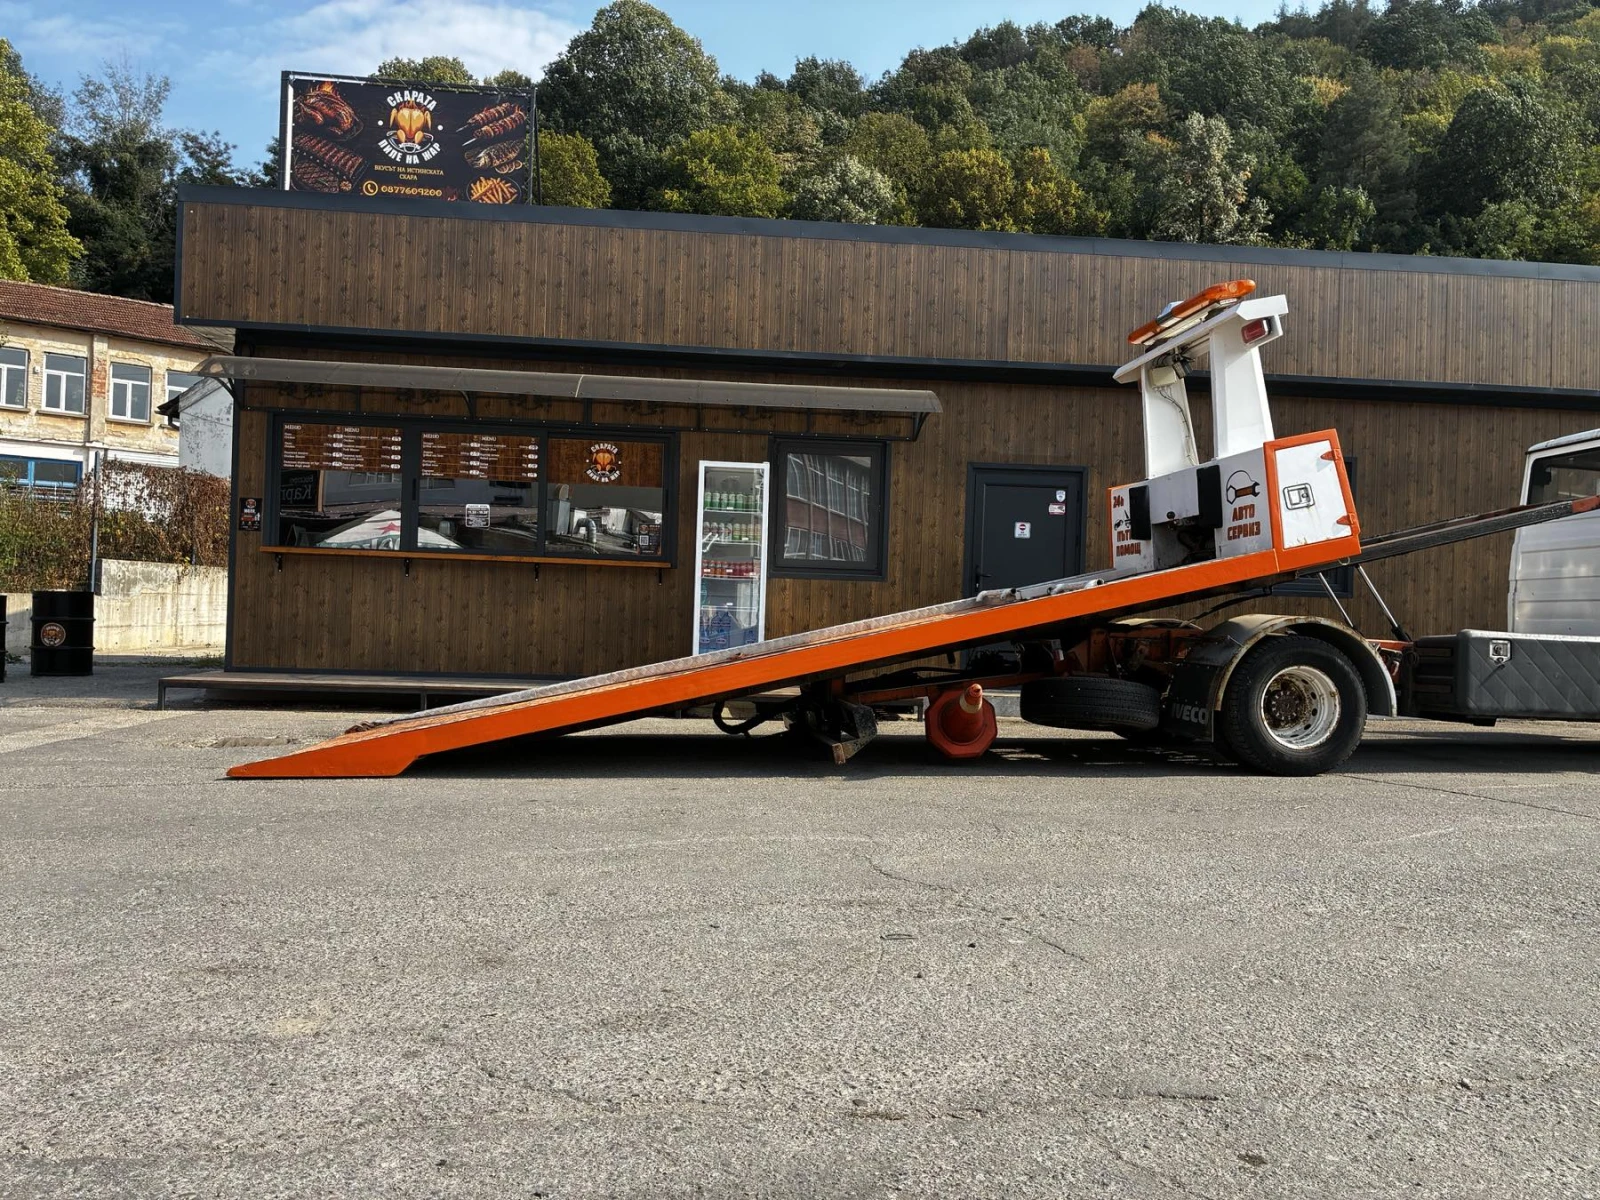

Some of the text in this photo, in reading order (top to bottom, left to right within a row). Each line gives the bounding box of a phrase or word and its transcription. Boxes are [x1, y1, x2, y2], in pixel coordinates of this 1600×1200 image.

[386, 90, 437, 111] СКАРАТА
[377, 138, 441, 165] ПИЛЕ НА ЖАР
[374, 164, 396, 172] ВКУСЪТ
[406, 167, 444, 176] ИСТИНСКАТА
[380, 185, 443, 197] 0877609200
[1232, 503, 1256, 522] АВТО
[1227, 521, 1261, 541] СЕРВИЗ
[1116, 542, 1141, 557] ПОМОЩ
[1171, 703, 1209, 725] IVECO
